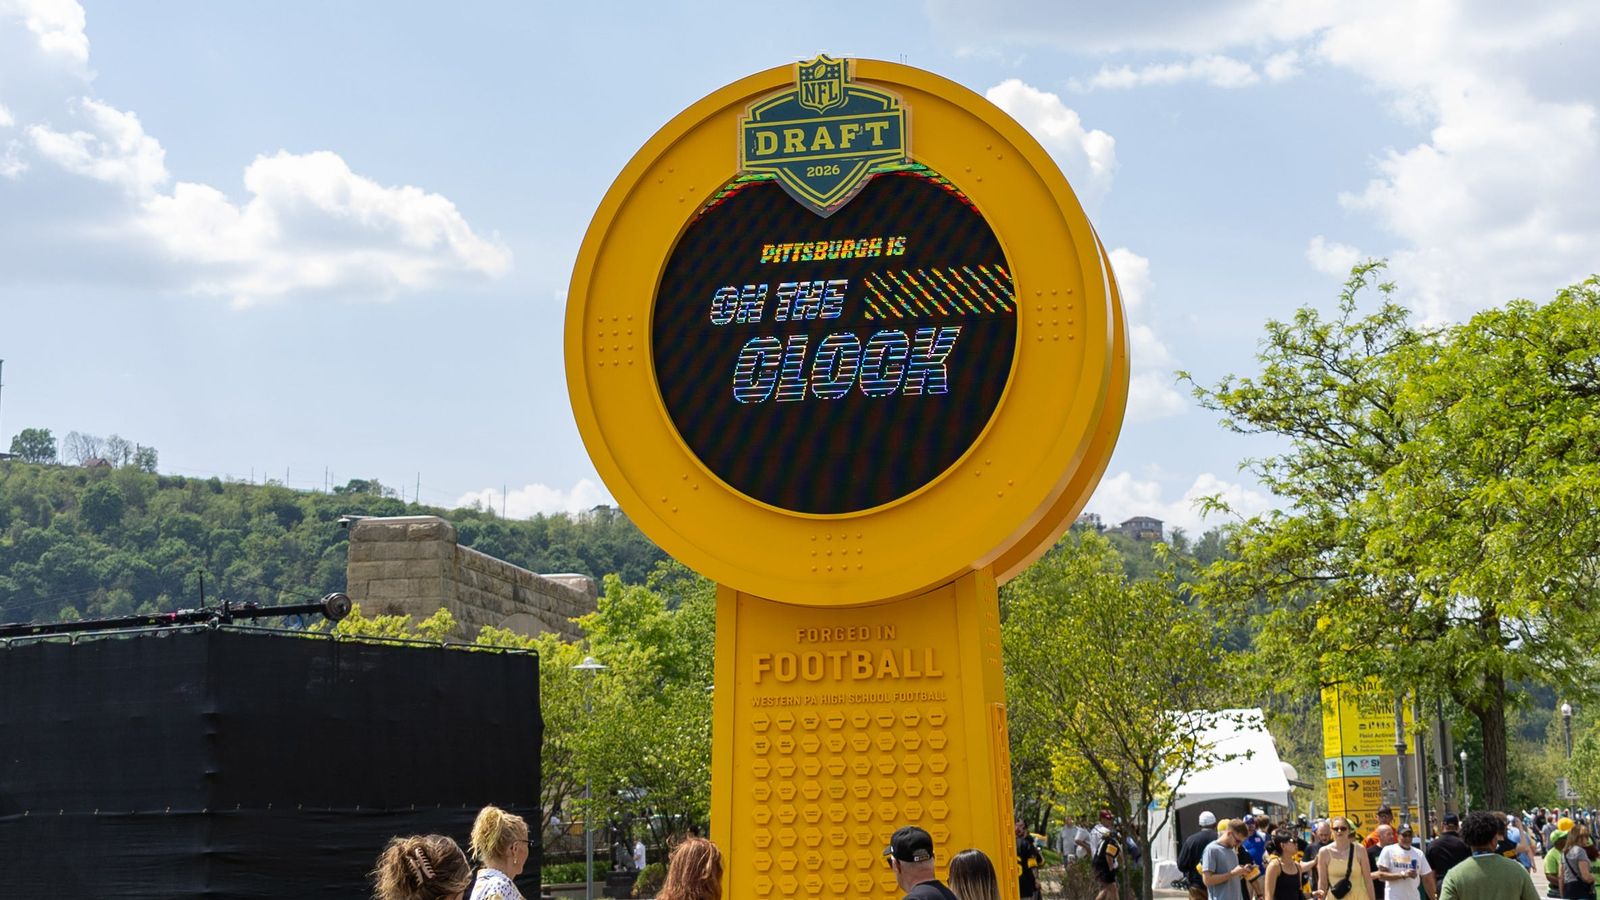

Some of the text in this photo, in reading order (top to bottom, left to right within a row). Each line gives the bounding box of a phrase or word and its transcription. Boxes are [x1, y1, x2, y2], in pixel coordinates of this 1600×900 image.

[803, 81, 838, 104] NFL
[755, 121, 889, 156] DRAFT
[806, 165, 841, 177] 2026
[760, 236, 907, 264] PITTSBURGH IS
[709, 279, 848, 325] ON THE
[733, 326, 962, 403] CLOCK
[797, 625, 896, 642] FORGED IN
[752, 648, 944, 683] FOOTBALL
[752, 690, 946, 707] WESTERN PA HIGH SCHOOL FOOTBALL
